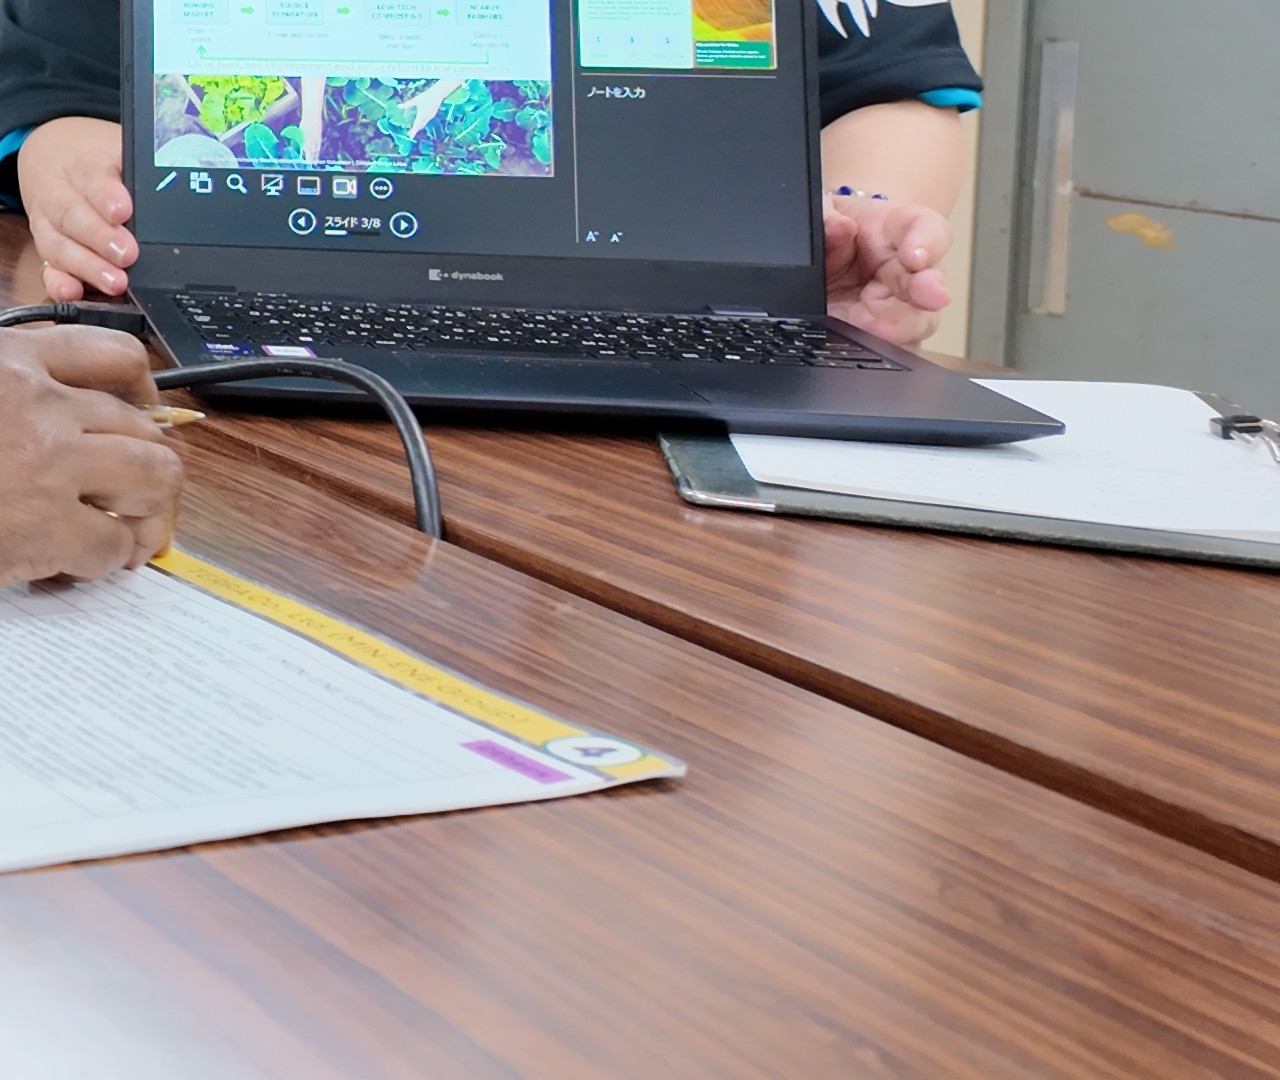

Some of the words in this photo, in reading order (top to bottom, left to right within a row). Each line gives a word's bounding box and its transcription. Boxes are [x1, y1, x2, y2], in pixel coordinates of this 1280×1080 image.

[587, 86, 646, 99] ノートを入力
[324, 216, 359, 228] スライド
[361, 217, 381, 229] 3/8
[451, 270, 504, 281] dynabook
